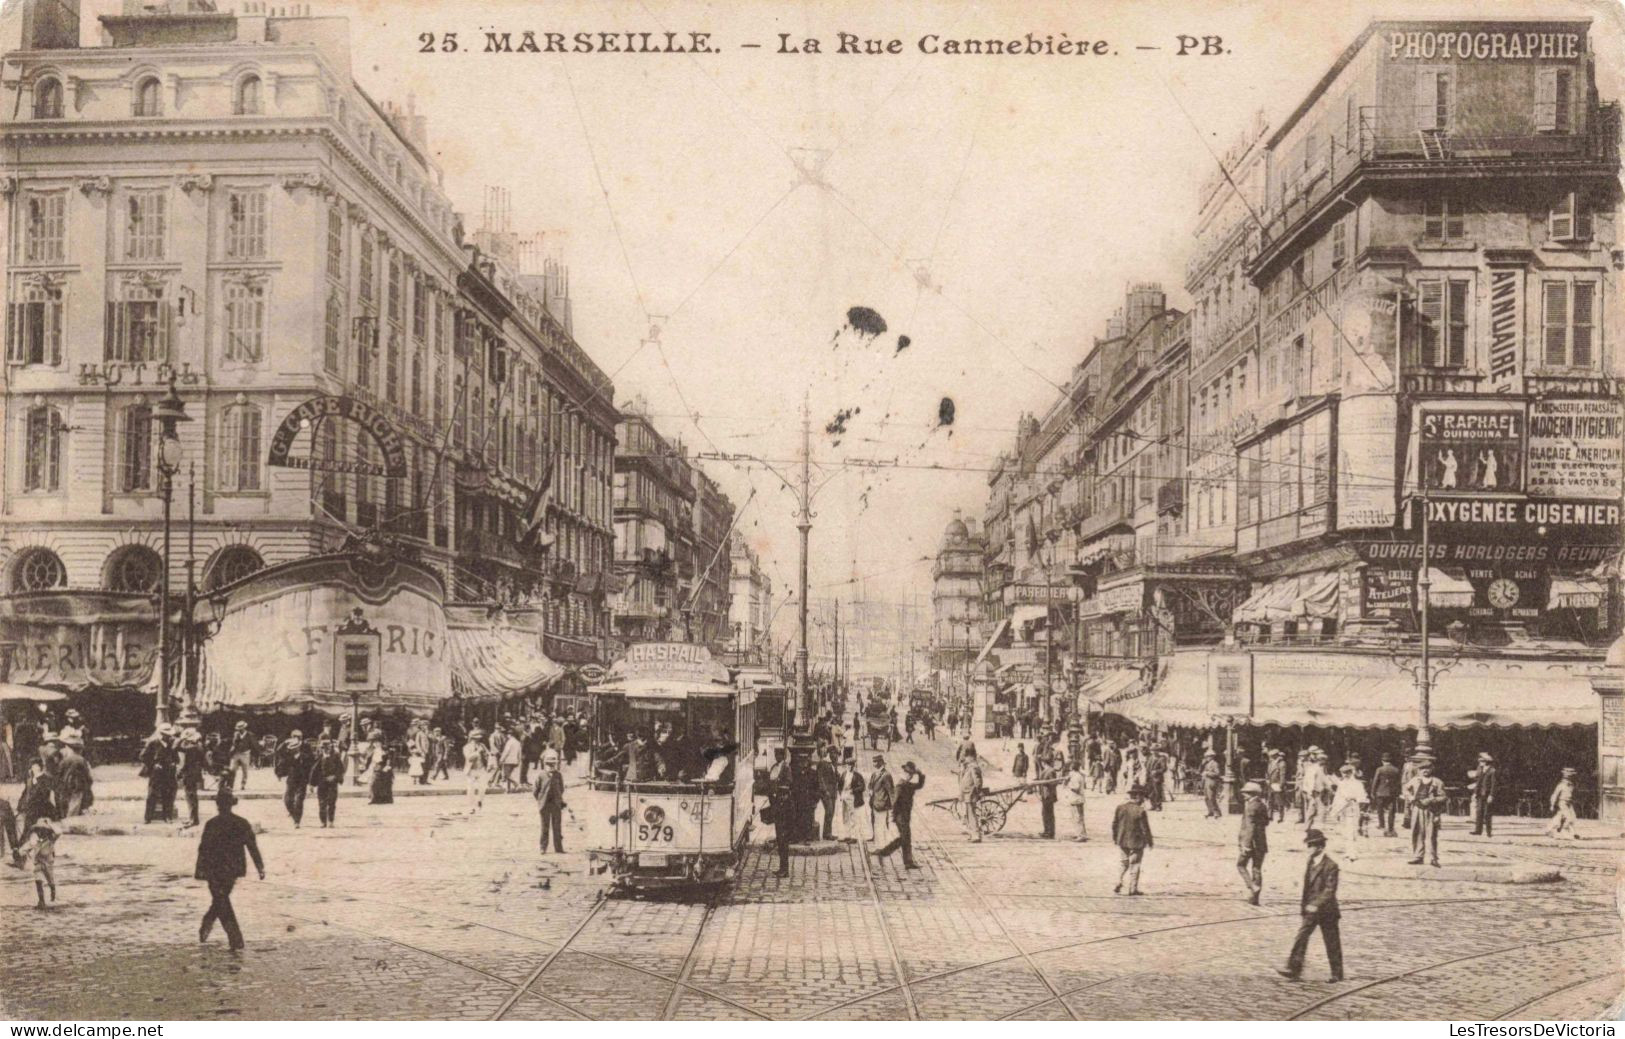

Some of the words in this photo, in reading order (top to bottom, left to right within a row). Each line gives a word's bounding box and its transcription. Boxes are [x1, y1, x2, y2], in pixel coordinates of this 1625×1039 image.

[1389, 31, 1579, 60] PHOTOGRAPHIE
[1492, 271, 1516, 384] ANNUAIRE
[348, 401, 402, 465] RICHE
[1524, 504, 1620, 524] CUSENIER
[1369, 543, 1448, 558] OUVRIERS
[1454, 545, 1549, 560] HORLOGERS
[1470, 570, 1493, 578] VENTE
[638, 825, 673, 842] 579
